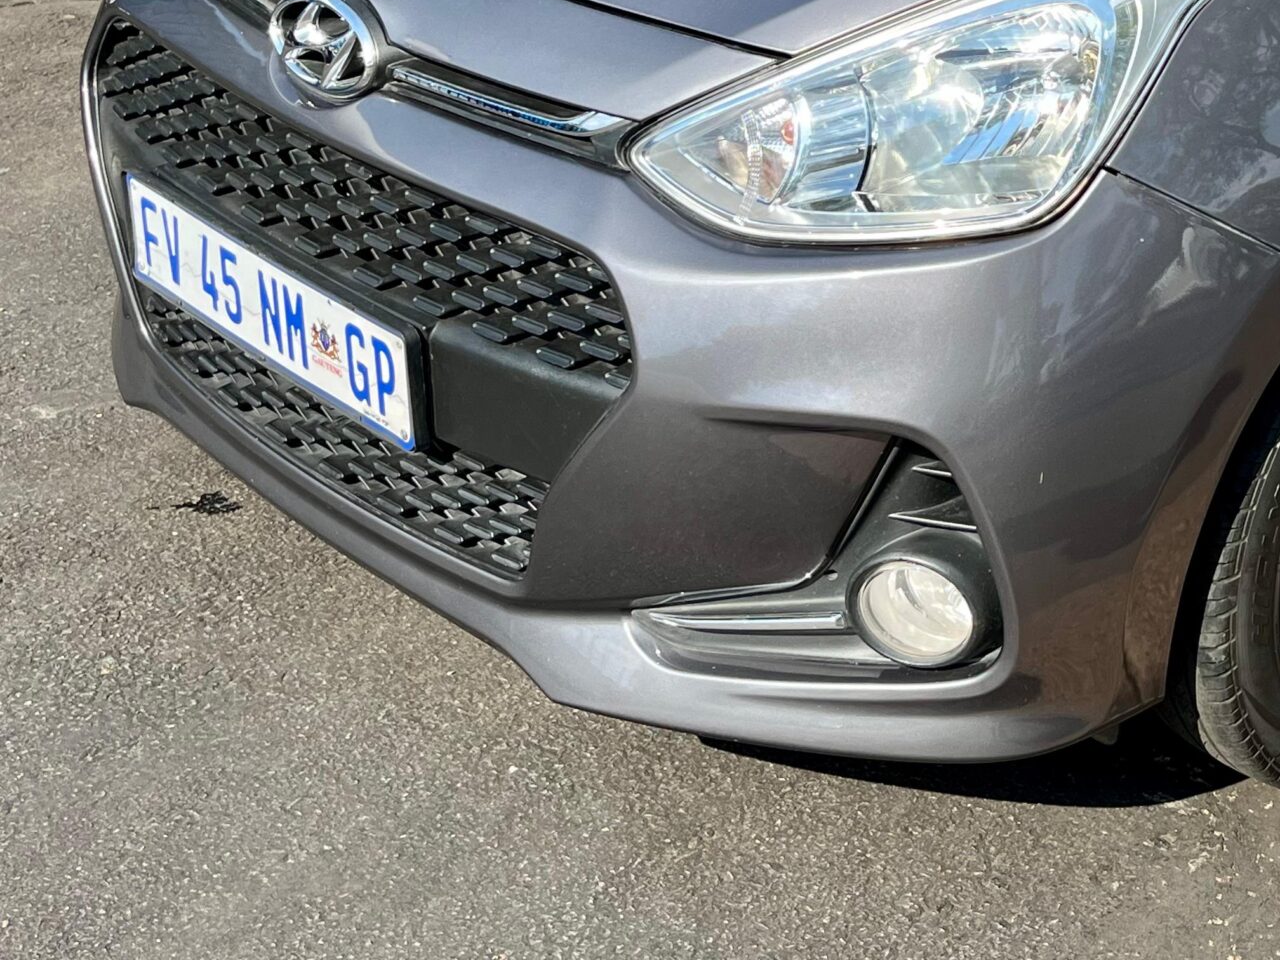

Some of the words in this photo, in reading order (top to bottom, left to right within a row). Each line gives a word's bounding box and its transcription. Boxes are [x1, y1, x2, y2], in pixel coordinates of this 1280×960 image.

[140, 195, 181, 286] FV
[201, 234, 244, 326] 45
[257, 269, 310, 371] NM
[344, 322, 396, 417] GP
